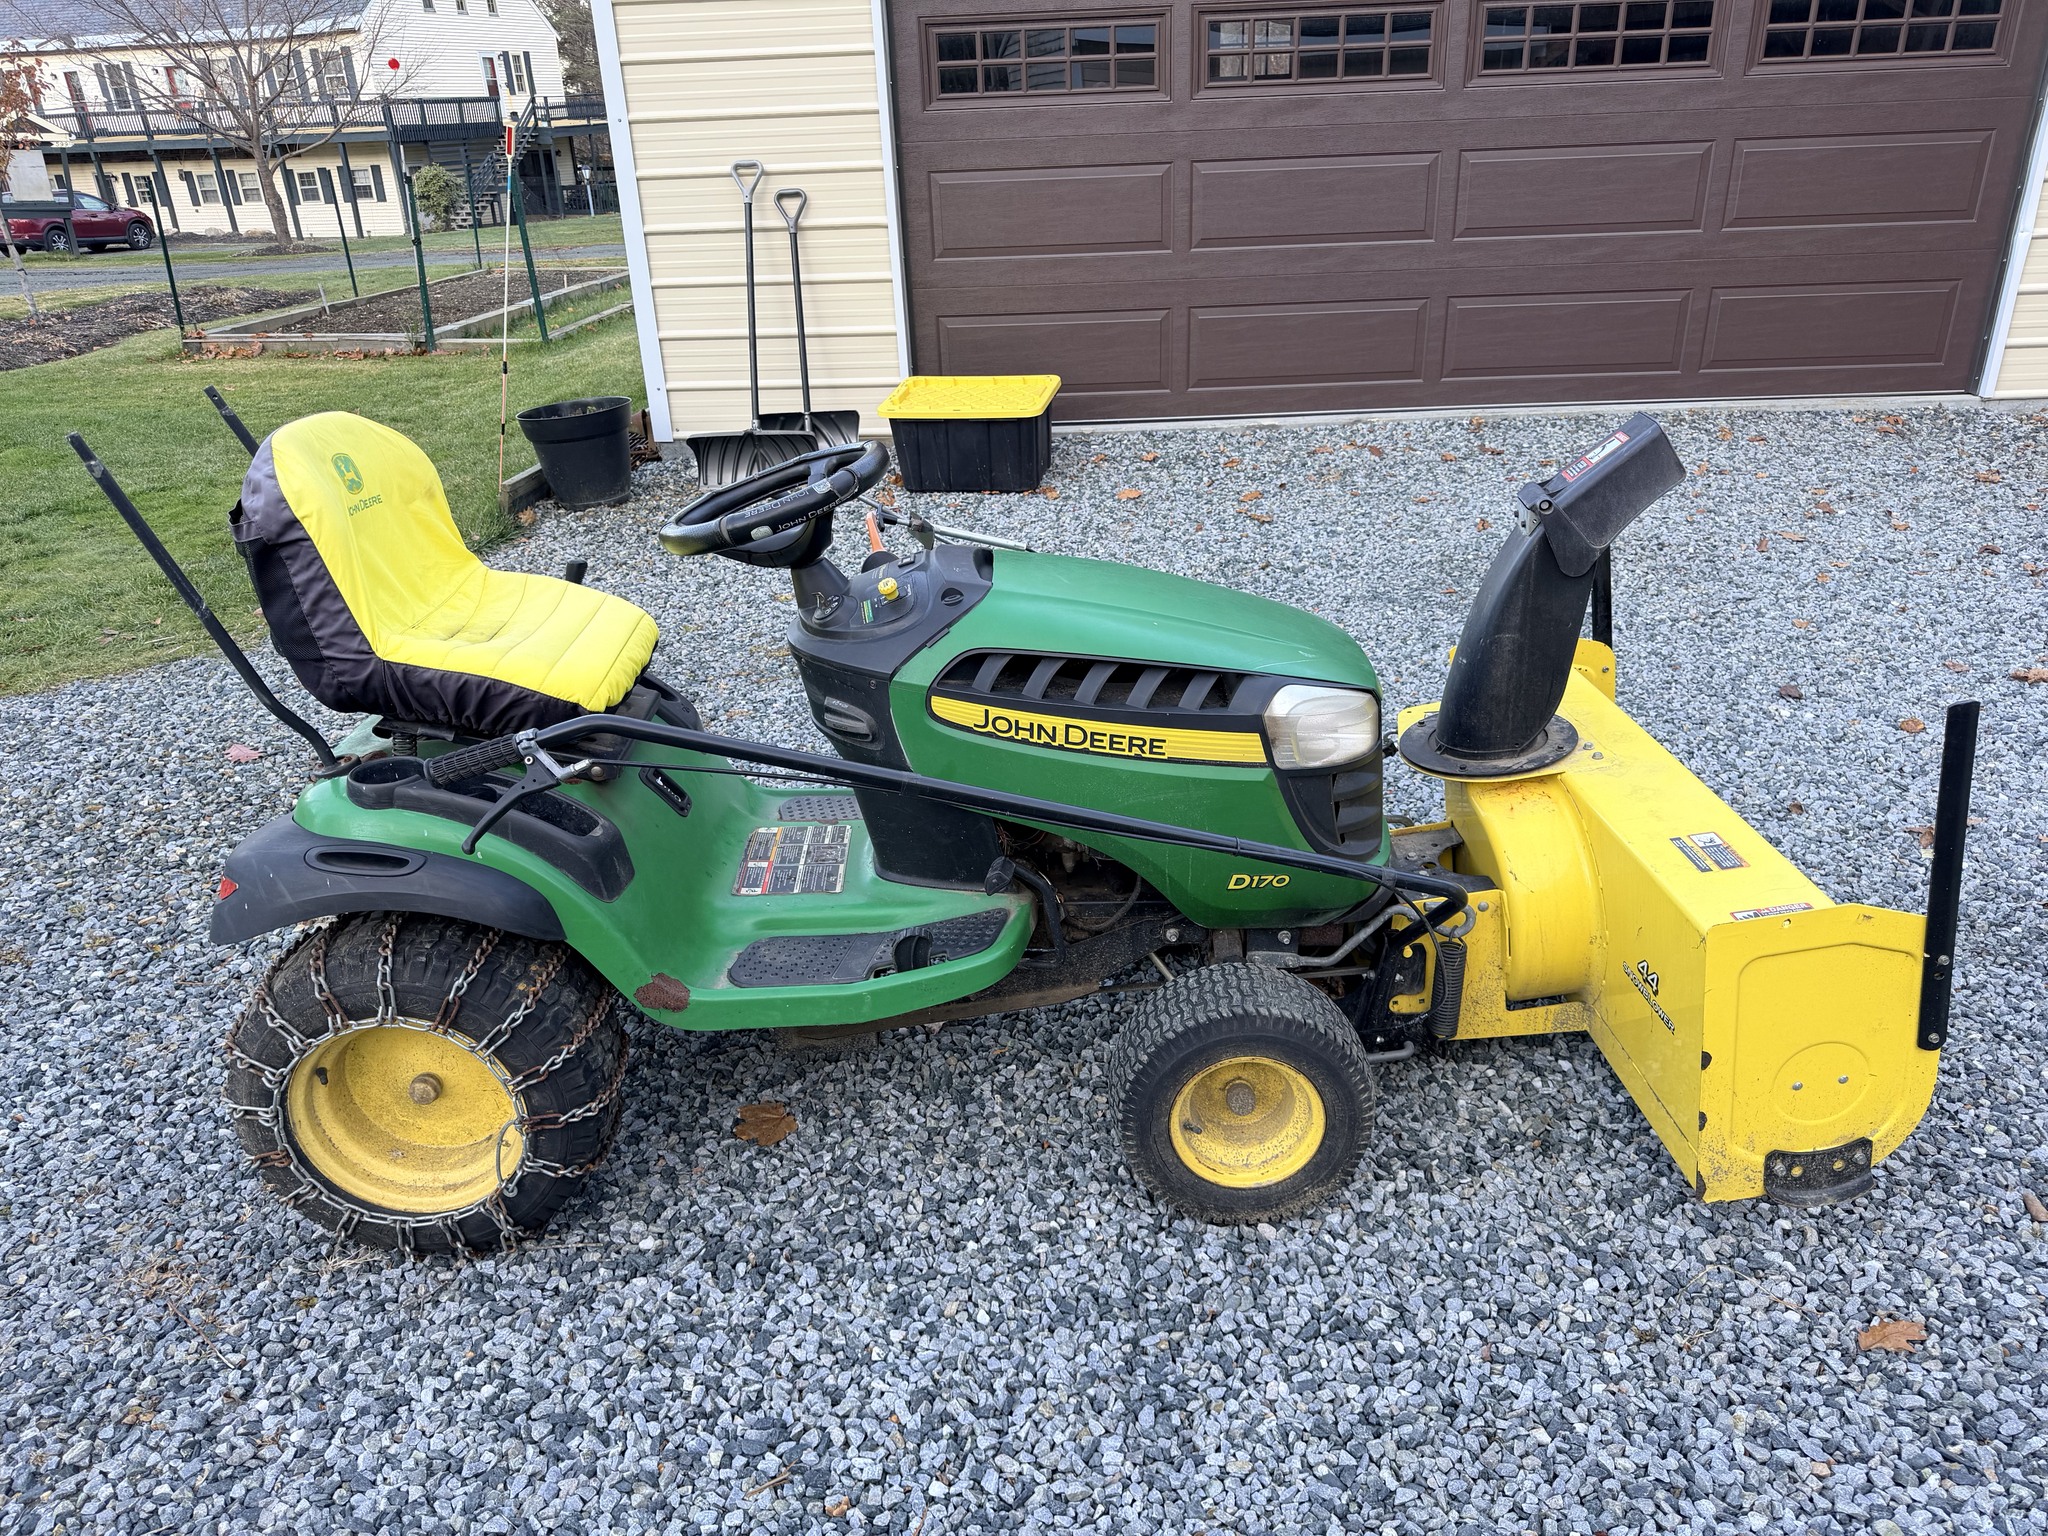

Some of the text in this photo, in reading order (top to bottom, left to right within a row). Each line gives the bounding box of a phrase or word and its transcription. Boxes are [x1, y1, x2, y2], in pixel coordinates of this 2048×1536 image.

[359, 494, 383, 511] DEERE
[776, 498, 843, 532] JOHN DEERE
[973, 709, 1167, 757] JOHN DEERE
[1227, 873, 1291, 890] D170
[1769, 902, 1808, 913] DANGER
[1637, 960, 1659, 997] 44
[1623, 961, 1675, 1035] SNOWBLOWER
